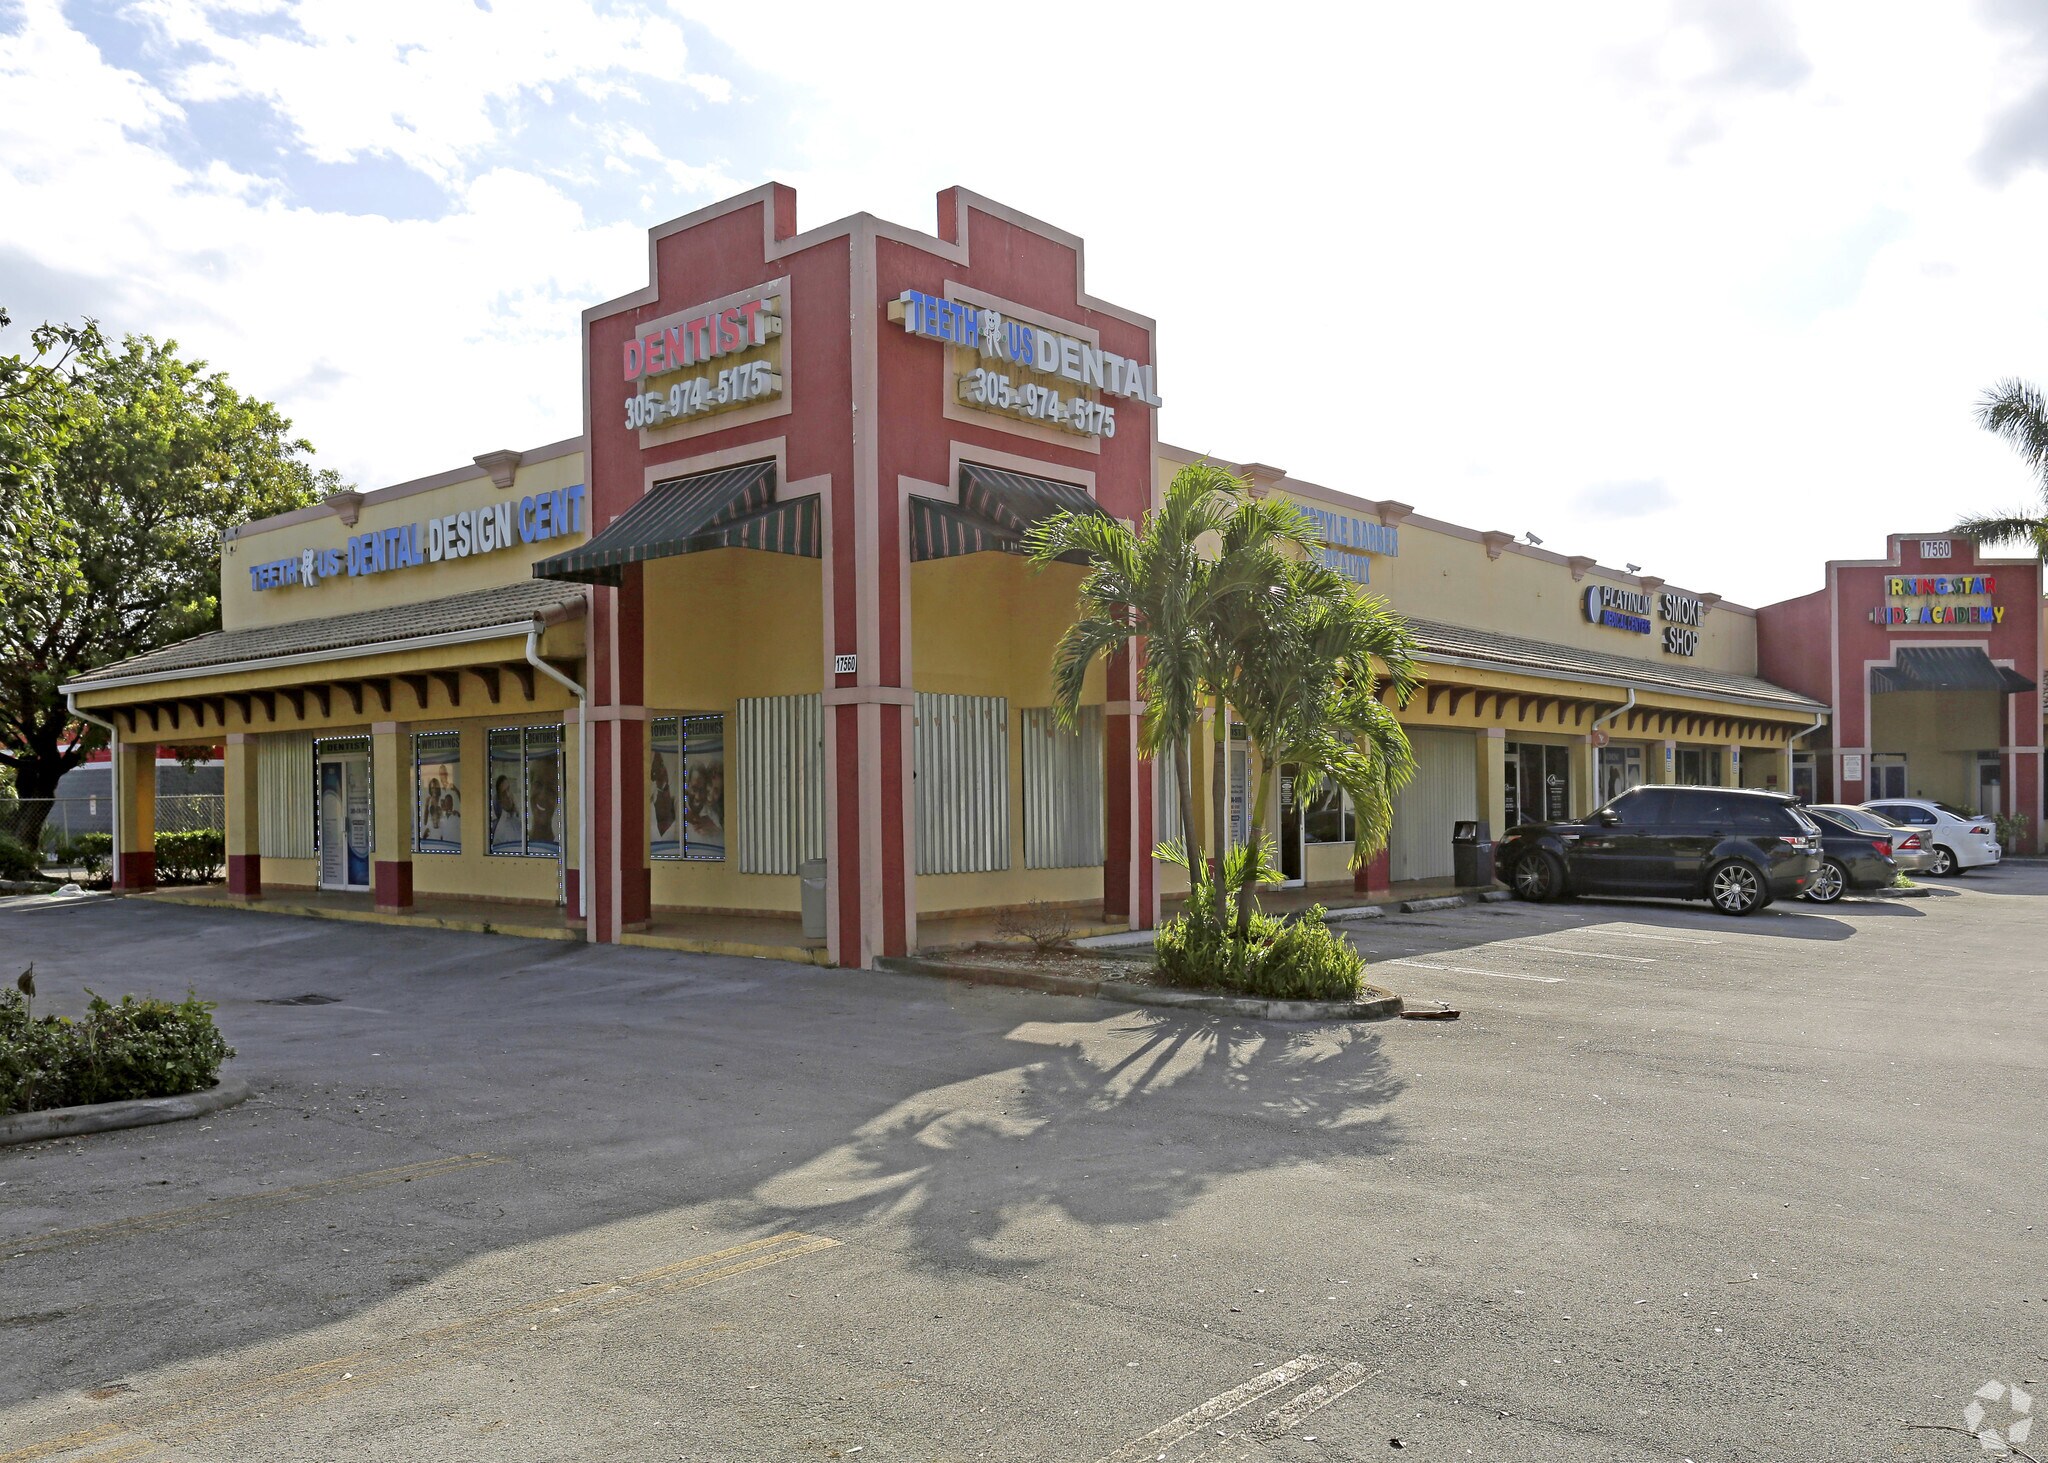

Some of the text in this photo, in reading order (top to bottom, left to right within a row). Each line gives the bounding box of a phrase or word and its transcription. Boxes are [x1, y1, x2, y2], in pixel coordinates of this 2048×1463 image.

[624, 300, 772, 382] DENTIST
[901, 289, 1163, 408] TEETH US DENTAL
[625, 361, 772, 430] 305-974-5175
[969, 367, 1116, 438] 305-974-5175
[249, 557, 298, 592] TEETH
[317, 547, 344, 577] US
[348, 523, 424, 577] DENTAL
[429, 501, 518, 563] DESIGN
[1352, 517, 1398, 558] BARBER
[1921, 541, 1950, 557] 17560
[1602, 586, 1652, 615] PLATINUM
[1890, 577, 1997, 595] RISING STAR
[1663, 593, 1704, 627] SMOKE
[1873, 606, 2005, 624] KIDS ACADEMY
[1667, 627, 1700, 656] SHOP
[836, 656, 855, 671] 17560
[327, 742, 366, 751] DENTIST
